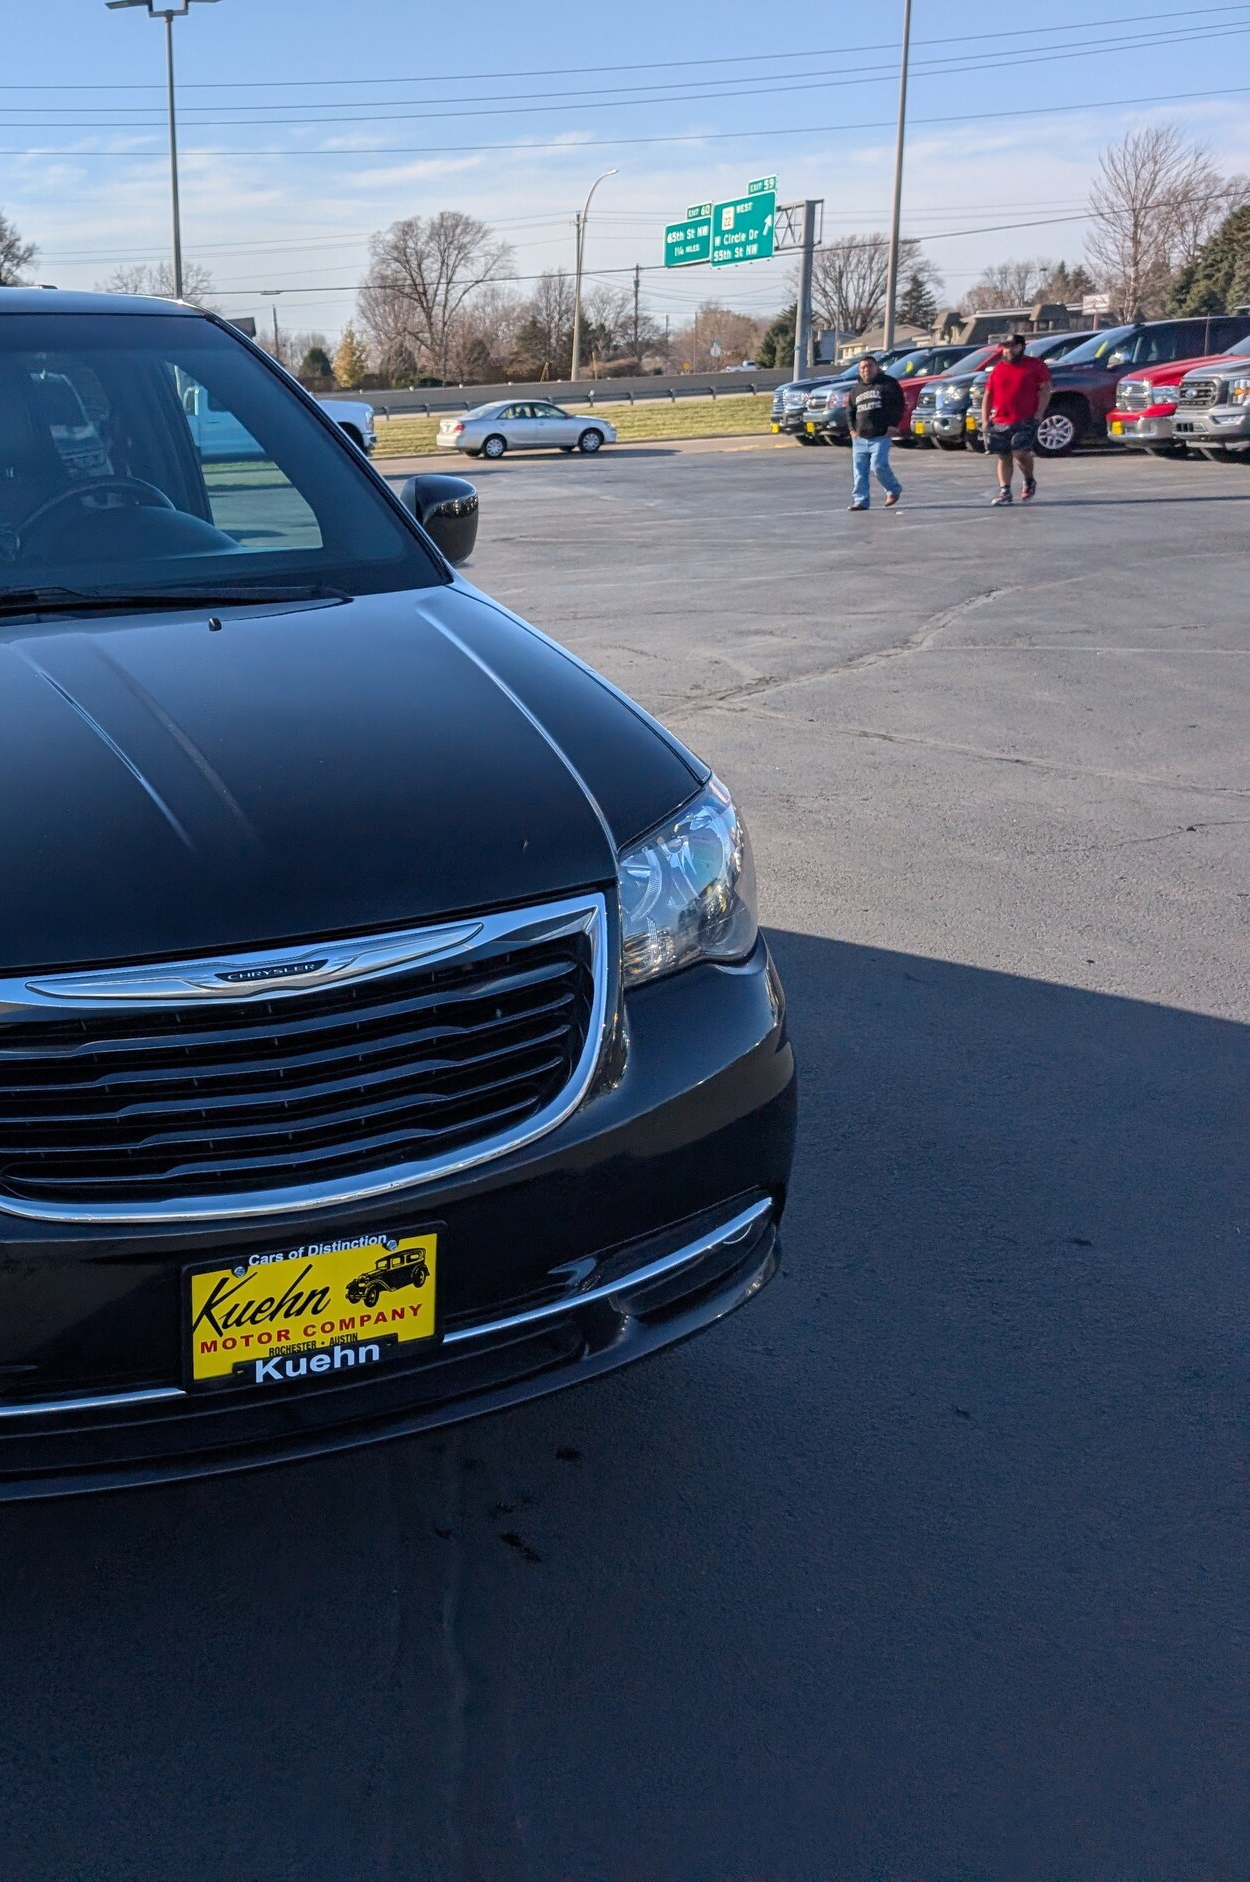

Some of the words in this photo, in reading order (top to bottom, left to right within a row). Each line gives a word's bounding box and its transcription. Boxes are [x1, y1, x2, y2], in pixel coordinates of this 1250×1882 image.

[750, 182, 762, 193] EXIT
[763, 178, 775, 190] 59
[688, 207, 700, 217] EXIT
[701, 204, 711, 216] 60
[736, 202, 753, 213] WEST
[723, 217, 732, 228] 22
[666, 231, 685, 244] 65th
[686, 228, 695, 240] St
[697, 225, 709, 237] NW
[723, 231, 746, 245] Circle
[748, 229, 759, 241] Dr
[713, 249, 732, 262] 55th
[734, 246, 744, 259] St
[746, 243, 758, 256] NW
[227, 964, 315, 980] CHRYSLER
[248, 1253, 284, 1267] Cars
[288, 1246, 305, 1261] of
[307, 1234, 388, 1258] Distinction
[193, 1263, 332, 1338] Kuehn
[200, 1328, 291, 1354] MOTOR
[302, 1303, 423, 1338] COMPANY
[268, 1340, 317, 1357] ROCHESTER
[329, 1332, 359, 1346] AUSTIN
[255, 1343, 380, 1383] Kuehn
